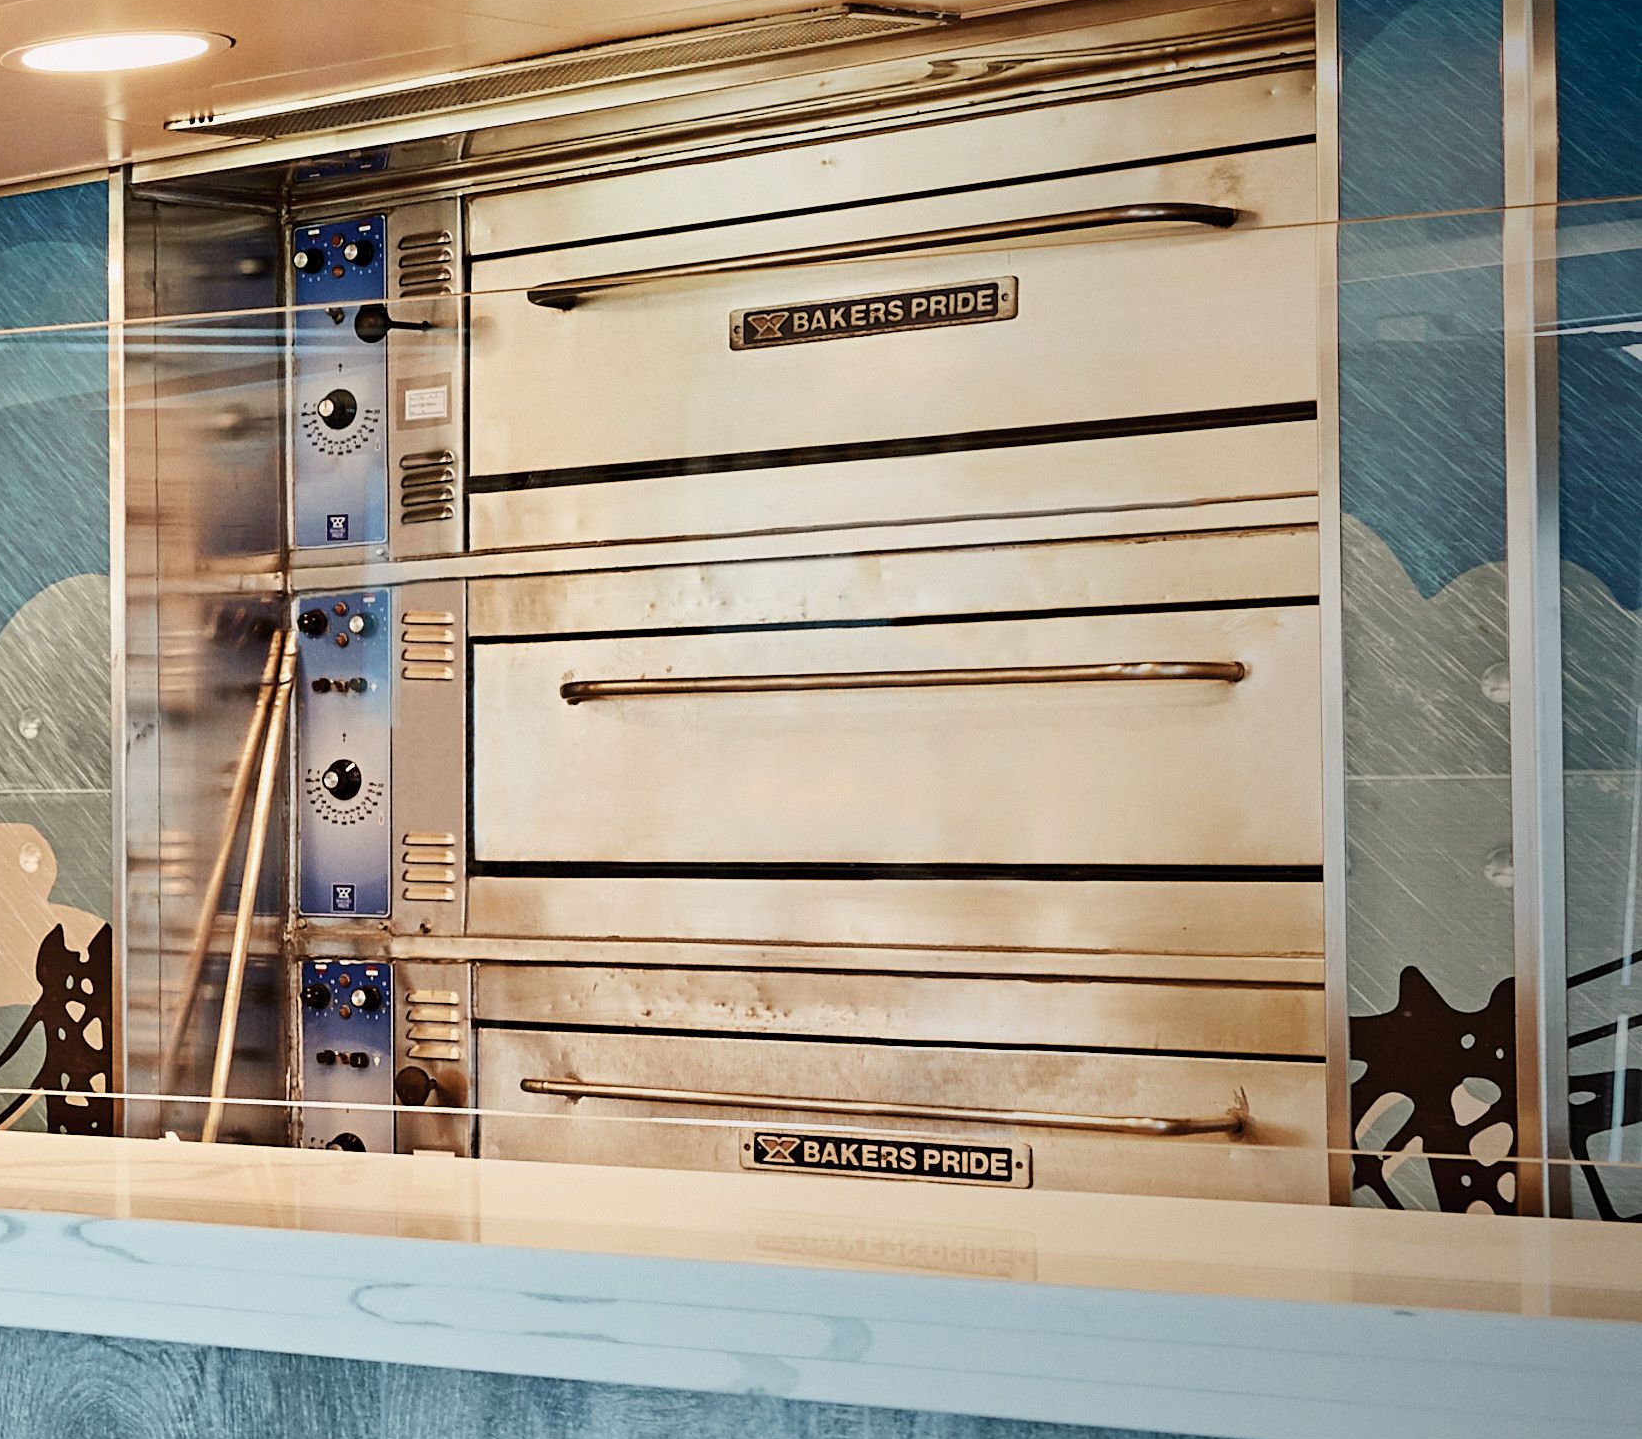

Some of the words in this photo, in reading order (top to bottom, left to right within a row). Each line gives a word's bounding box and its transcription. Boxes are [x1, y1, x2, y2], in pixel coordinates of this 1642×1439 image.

[792, 296, 905, 335] BAKERS
[909, 287, 995, 321] PRIDE
[803, 1140, 916, 1172] BAKERS
[923, 1148, 1009, 1177] PRIDE
